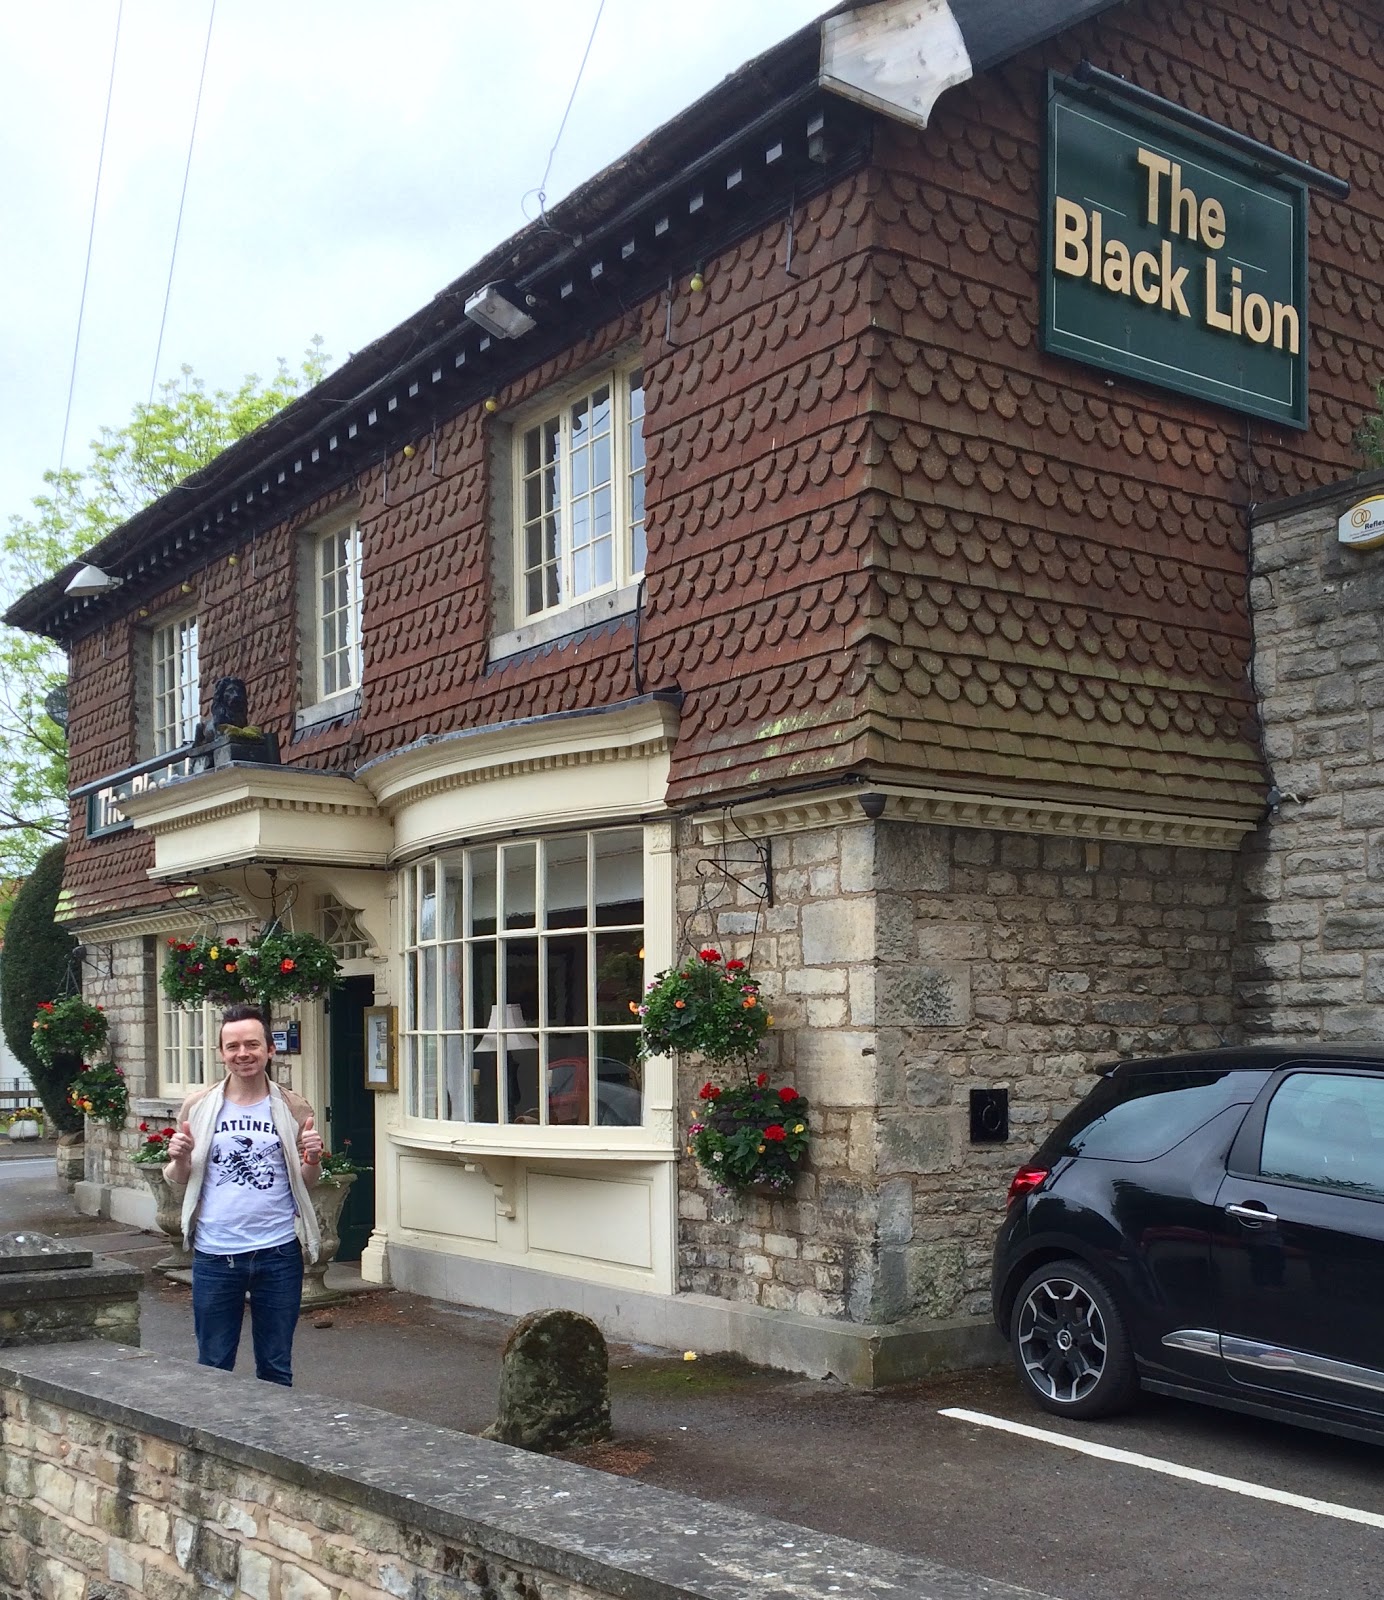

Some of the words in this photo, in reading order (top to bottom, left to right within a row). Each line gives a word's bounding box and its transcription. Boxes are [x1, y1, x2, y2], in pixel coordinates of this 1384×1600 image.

[1138, 147, 1226, 249] The
[1055, 195, 1191, 318] Black
[1206, 256, 1299, 354] Lion
